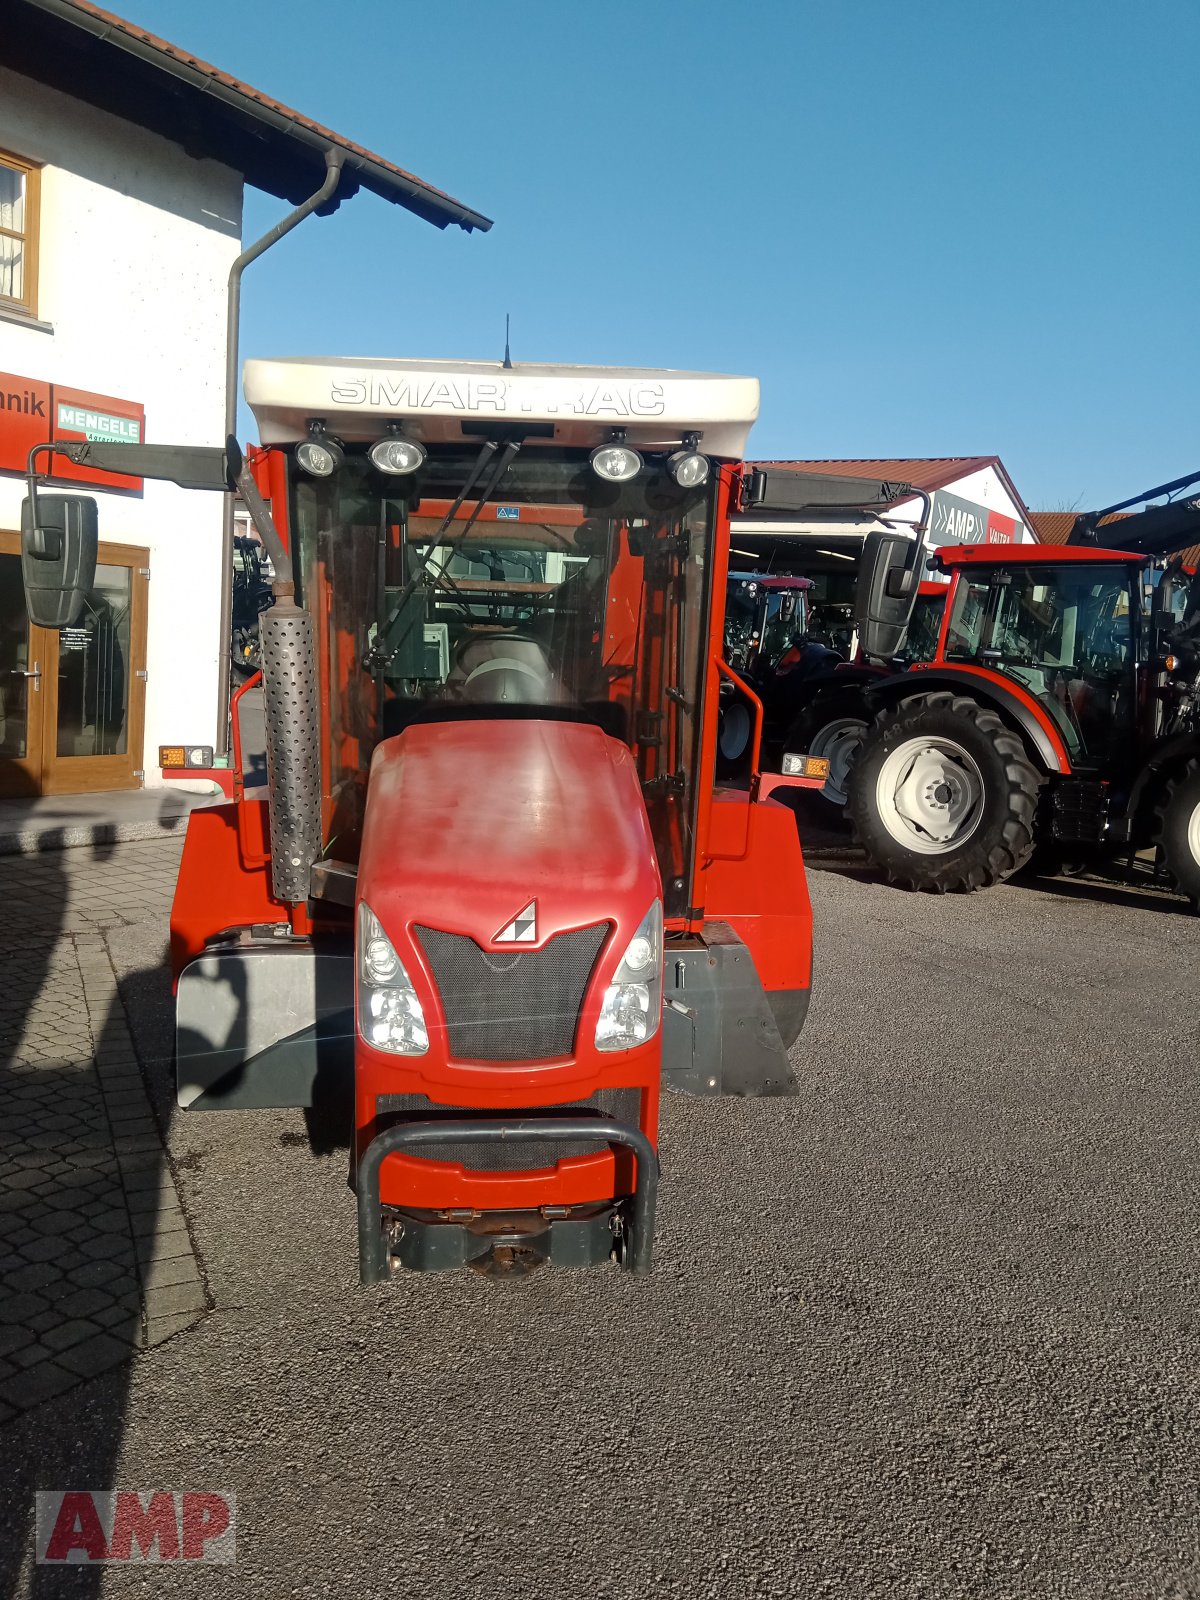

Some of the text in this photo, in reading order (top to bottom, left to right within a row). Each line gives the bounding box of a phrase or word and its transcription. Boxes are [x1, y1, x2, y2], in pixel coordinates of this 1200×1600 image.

[331, 376, 665, 416] SMARTRAC
[60, 408, 138, 438] MENGELE
[945, 507, 975, 540] AMP
